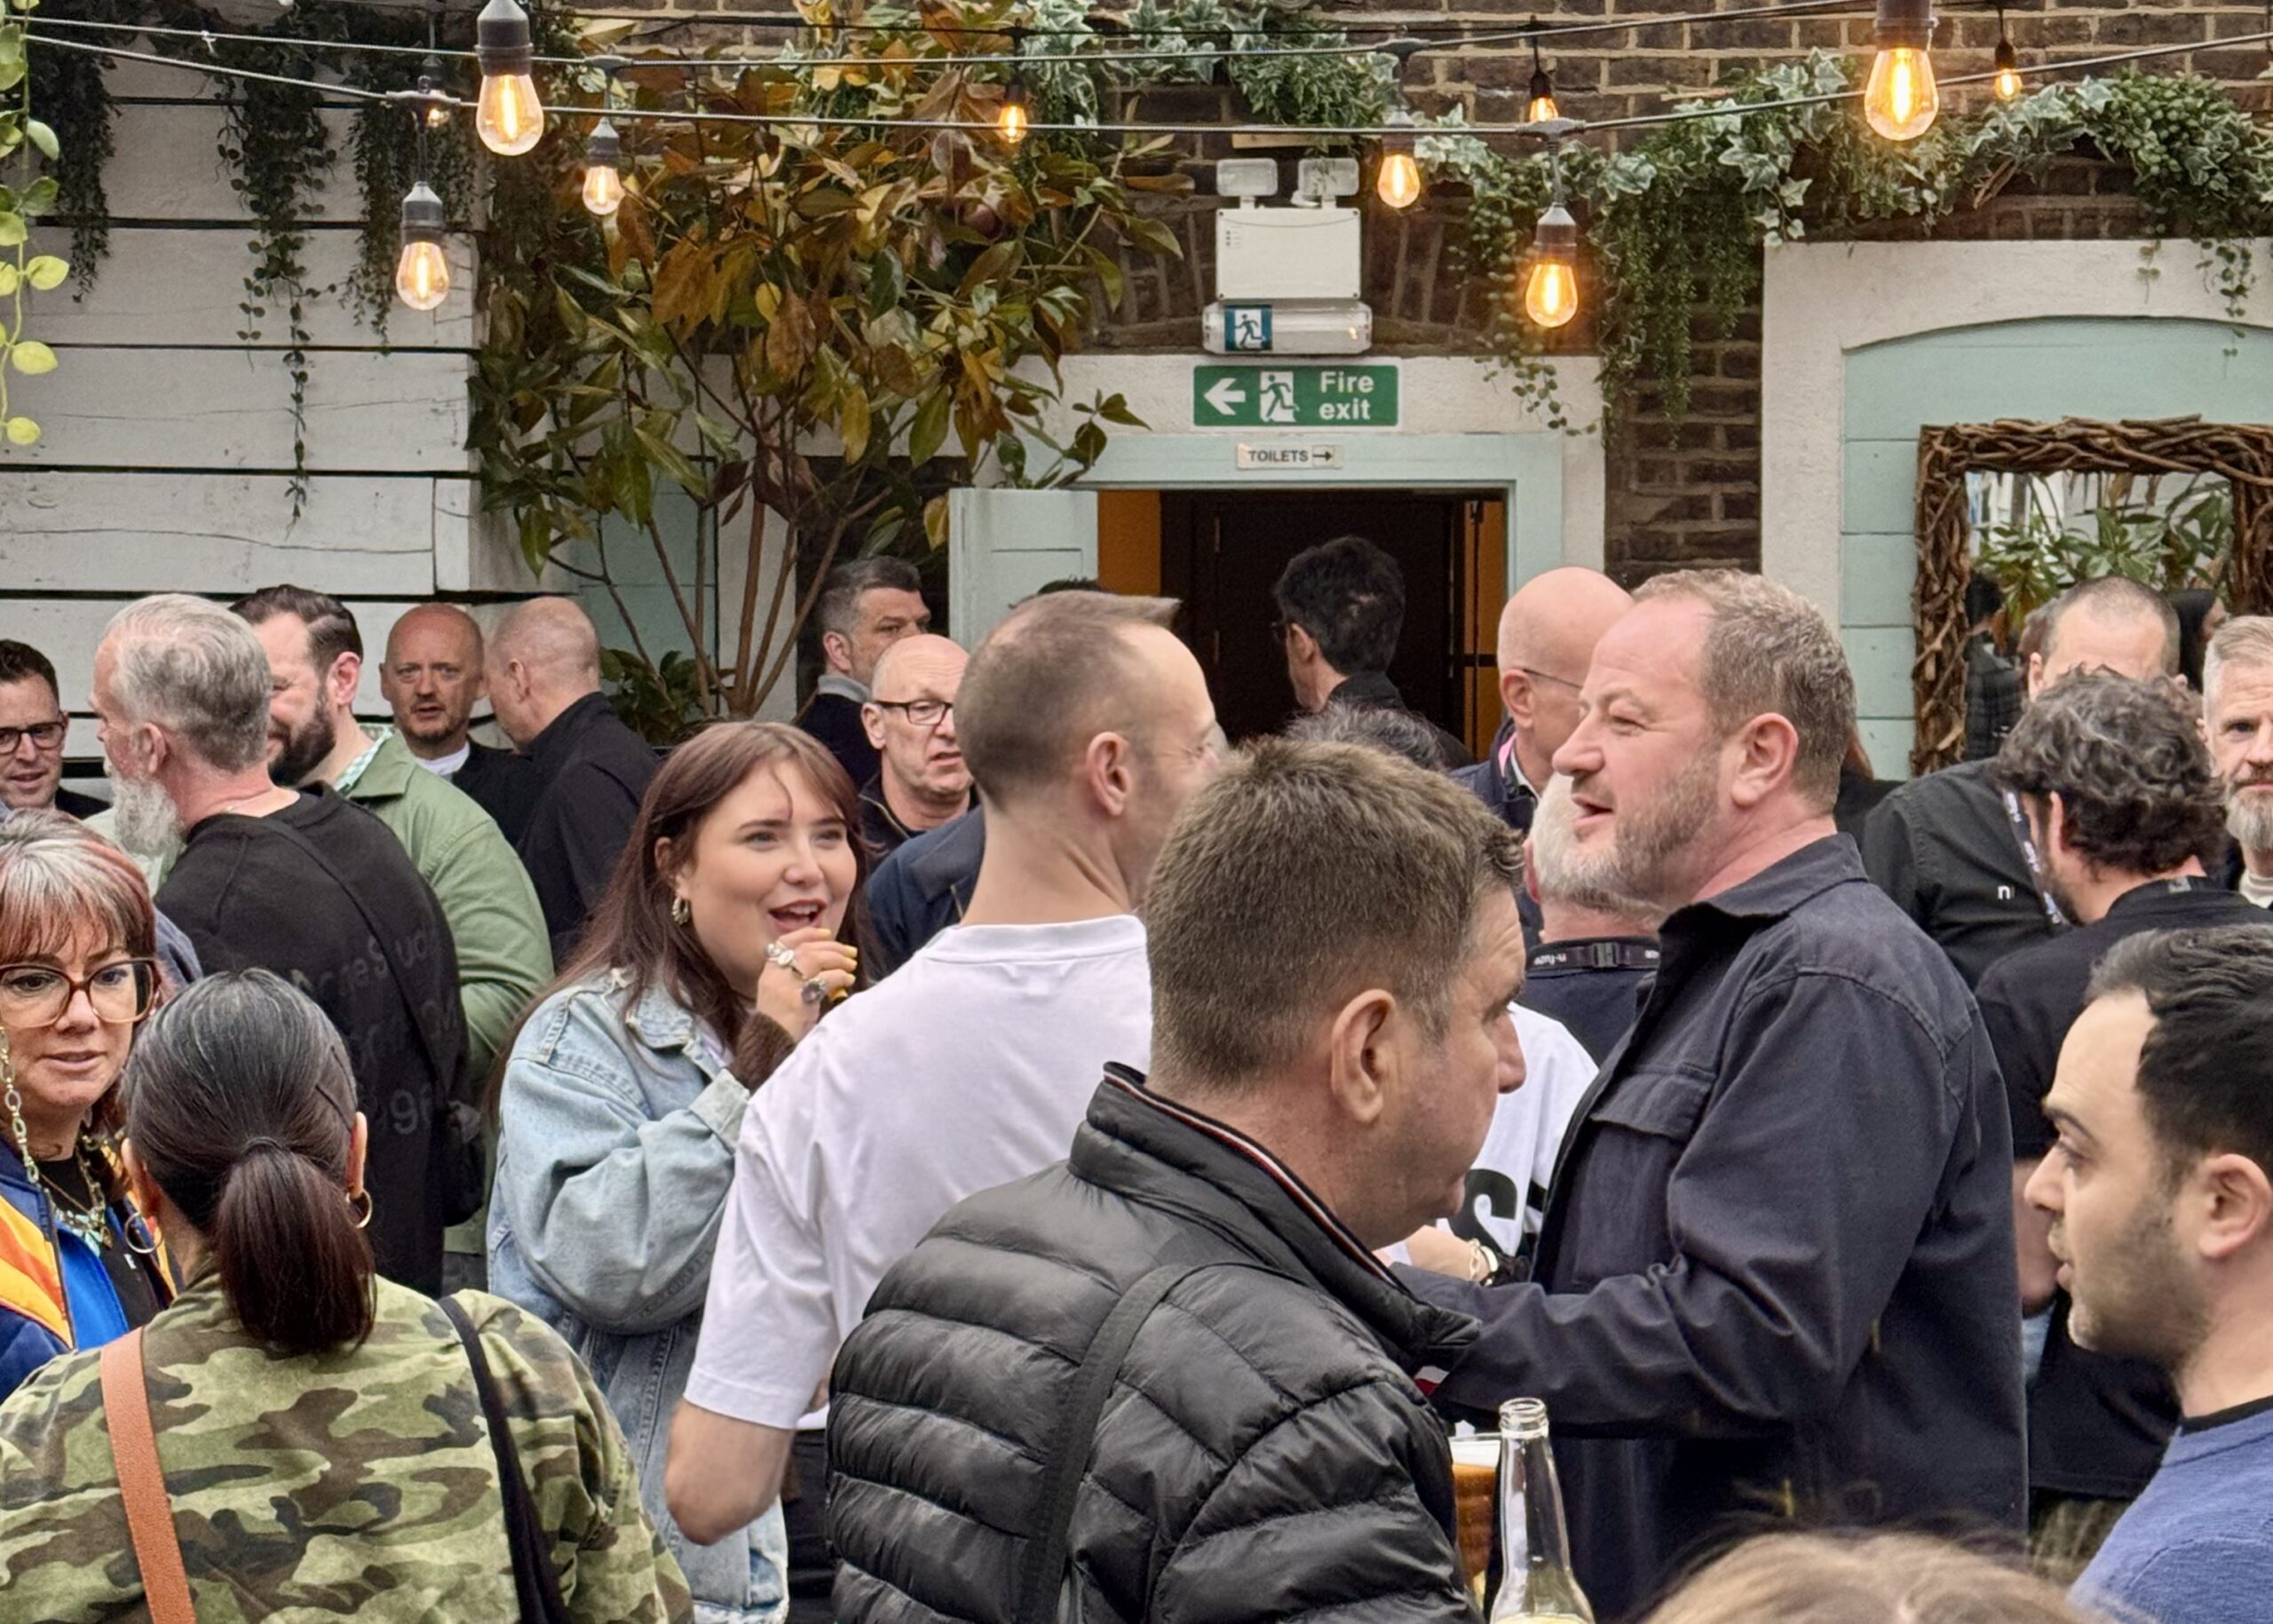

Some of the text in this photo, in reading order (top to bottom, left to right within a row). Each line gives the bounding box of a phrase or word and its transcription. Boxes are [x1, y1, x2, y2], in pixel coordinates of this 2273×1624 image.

[1320, 371, 1374, 393] Fire
[1319, 399, 1371, 420] exit
[1248, 450, 1309, 462] TOILETS
